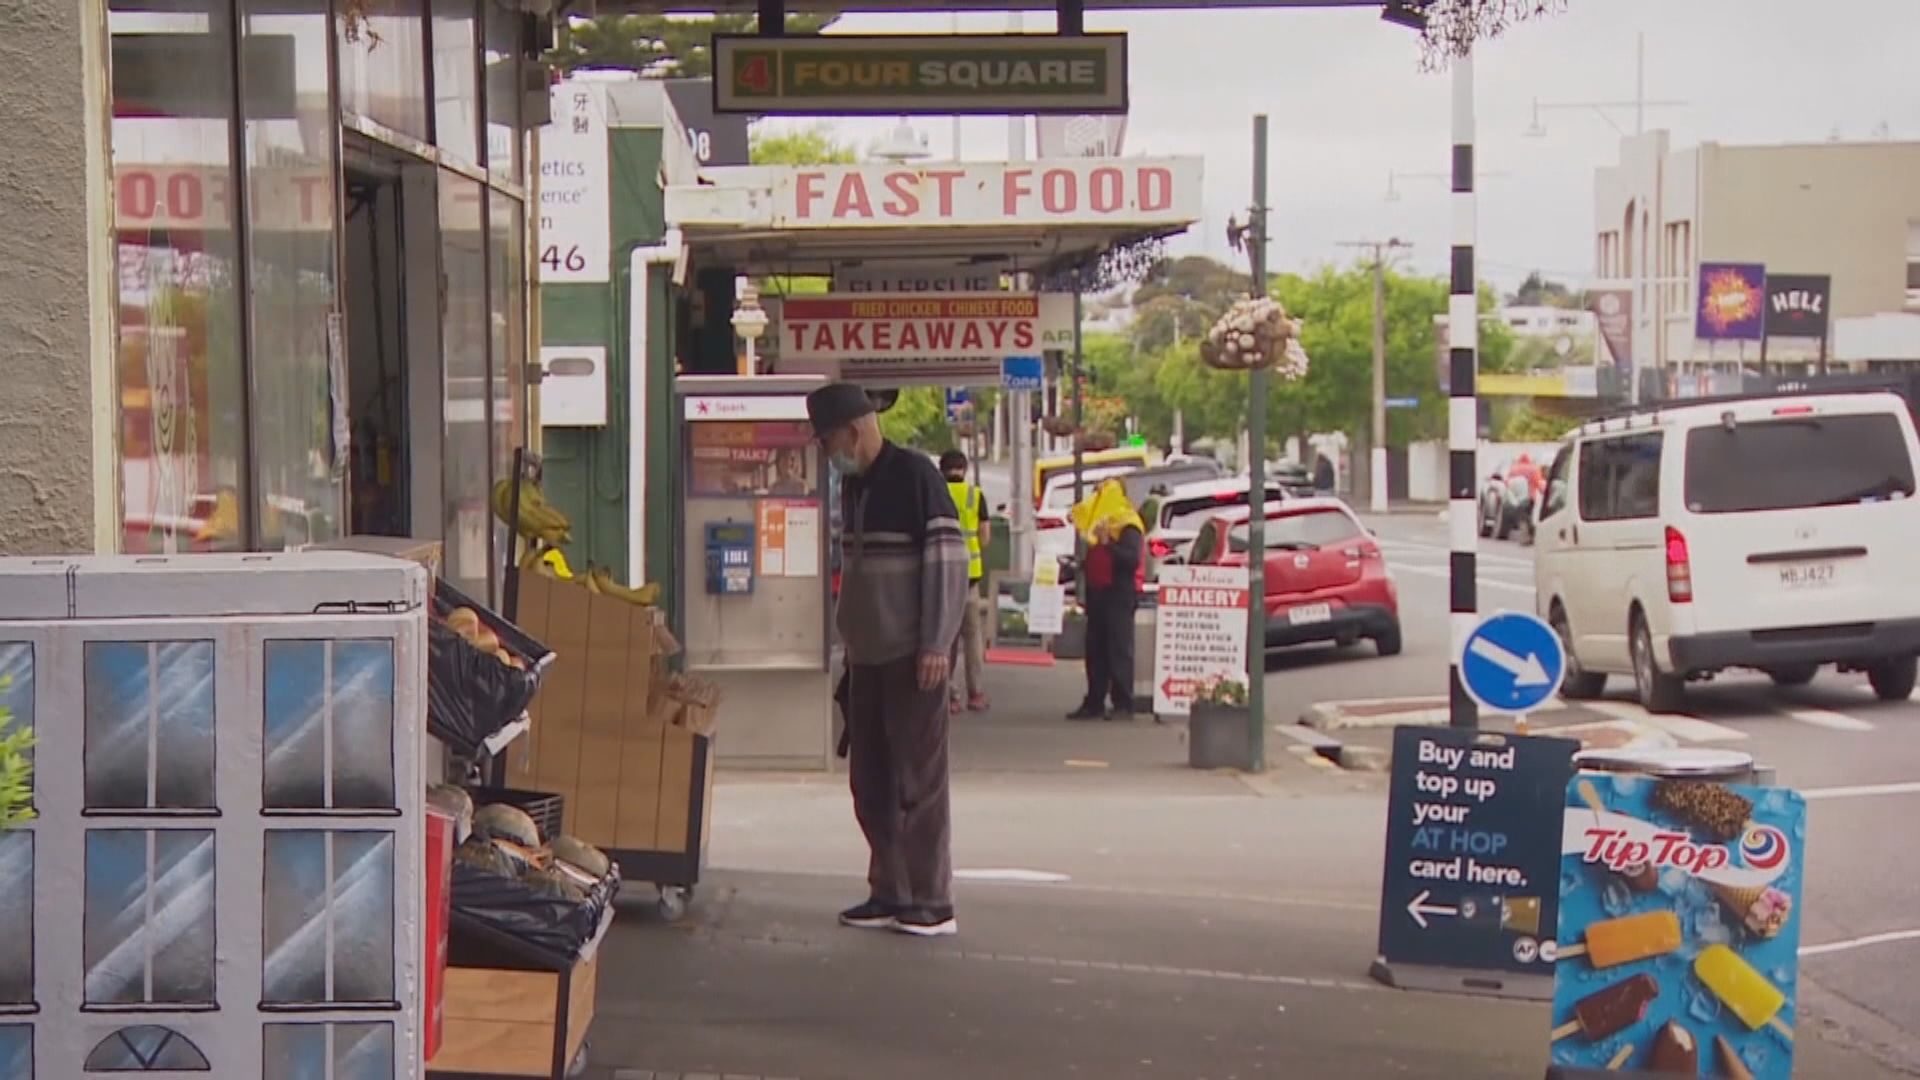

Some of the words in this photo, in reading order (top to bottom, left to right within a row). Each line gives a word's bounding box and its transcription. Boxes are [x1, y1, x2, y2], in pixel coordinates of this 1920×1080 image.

[738, 56, 769, 93] 4
[794, 61, 911, 86] FOUR
[919, 60, 1095, 87] SQUARE
[796, 171, 966, 219] FAST
[1003, 167, 1173, 216] FOOD
[541, 245, 585, 271] 46
[852, 302, 886, 317] FRIED
[889, 302, 941, 316] CHICKEN
[949, 301, 998, 316] CHINESE
[1001, 301, 1034, 316] FOOD
[1772, 290, 1822, 313] HELL
[788, 321, 1034, 352] TAKEAWAYS
[1165, 588, 1240, 606] BAKERY
[1418, 740, 1464, 770] Buy
[1469, 747, 1515, 769] and
[1416, 771, 1458, 798] top
[1465, 779, 1496, 802] up
[1412, 803, 1469, 825] your
[1411, 827, 1444, 849] AT
[1450, 831, 1508, 854] HOP
[1584, 829, 1648, 869] Tip
[1653, 834, 1727, 873] Top
[1409, 857, 1460, 880] card
[1467, 859, 1527, 886] here.
